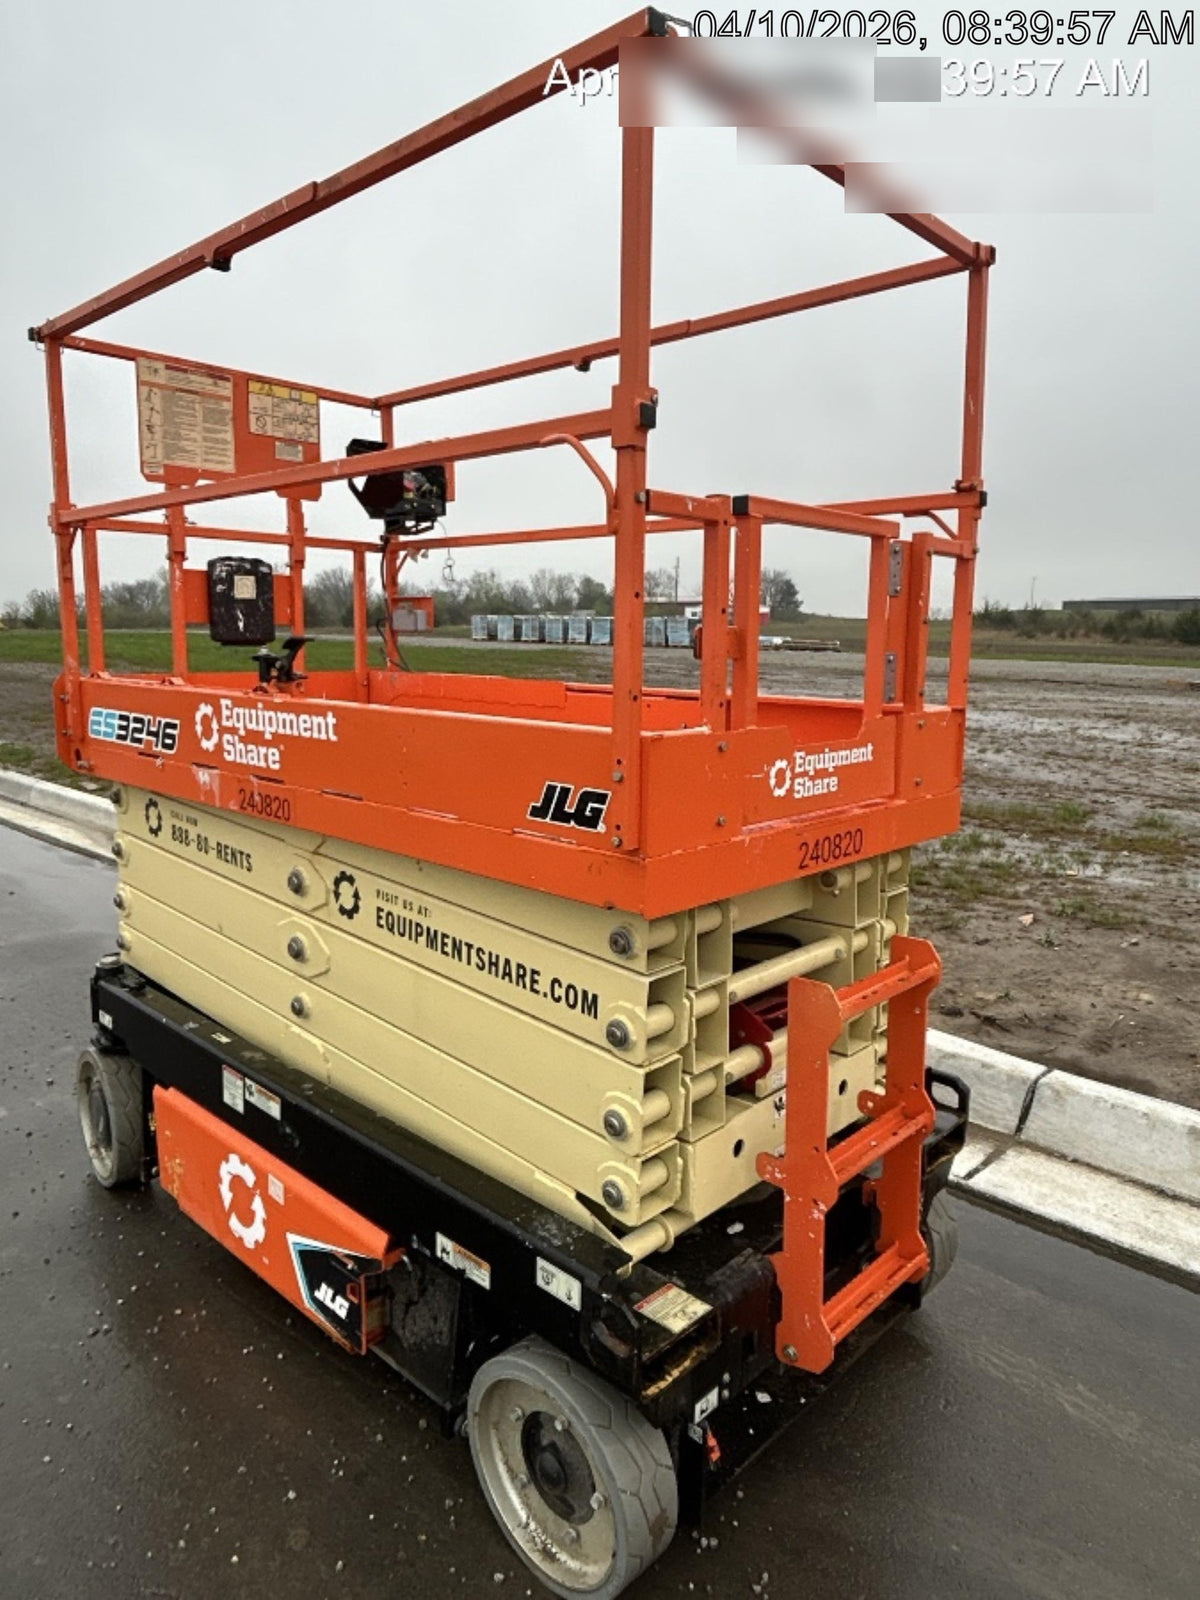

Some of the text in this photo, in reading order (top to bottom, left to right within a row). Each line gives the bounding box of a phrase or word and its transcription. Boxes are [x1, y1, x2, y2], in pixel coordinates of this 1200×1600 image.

[90, 709, 179, 752] ES3246
[220, 698, 338, 741] Equipment
[222, 733, 281, 770] Share
[793, 742, 873, 776] Equipment
[239, 788, 291, 822] 240820
[527, 782, 611, 832] JLG
[793, 776, 838, 799] Share
[171, 823, 253, 873] 888-80-RENTS
[798, 828, 864, 870] 240820
[376, 905, 600, 1020] EQUIPMENTSHARE.COM
[314, 1281, 350, 1321] JLG
